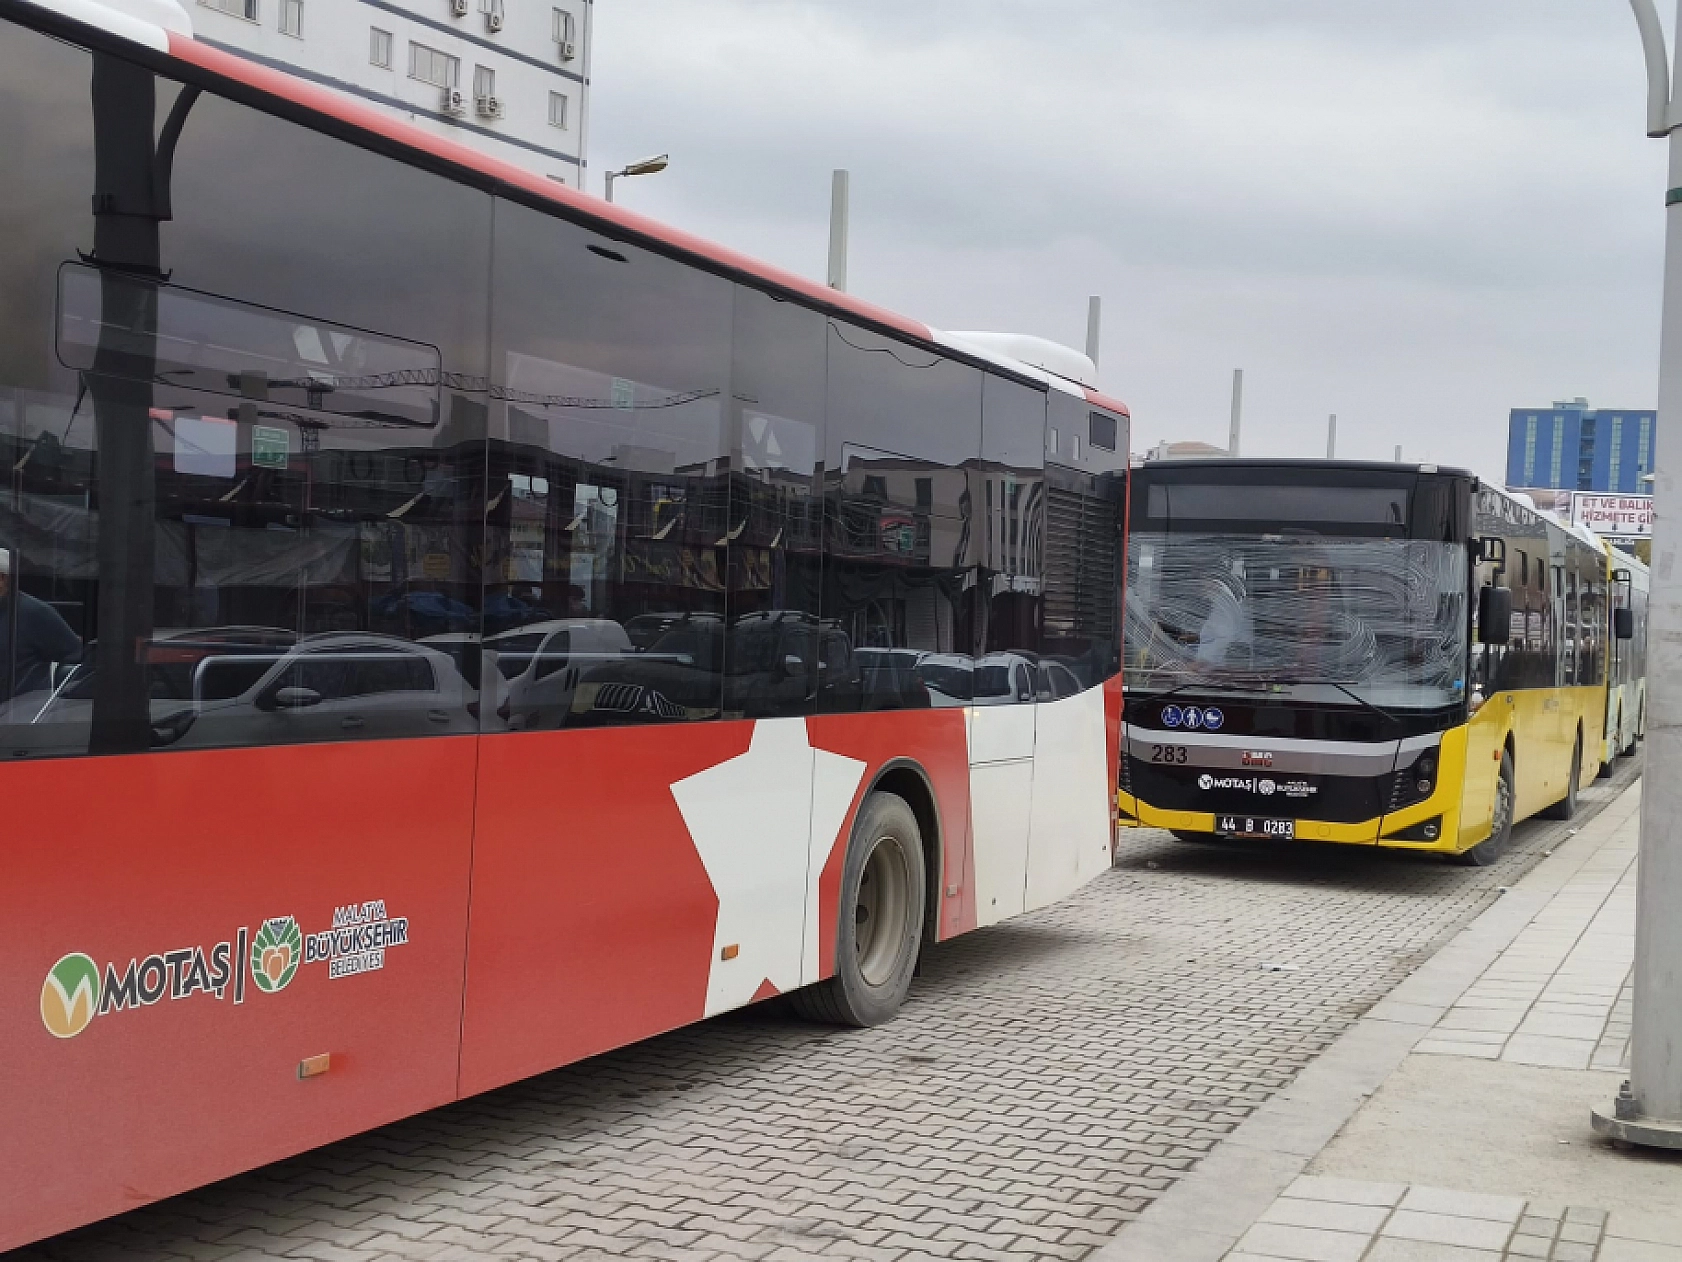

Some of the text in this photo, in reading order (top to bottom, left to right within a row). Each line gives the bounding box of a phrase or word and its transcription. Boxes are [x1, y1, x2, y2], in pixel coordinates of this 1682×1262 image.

[1582, 498, 1598, 508] ET
[1600, 498, 1617, 509] VE
[1581, 508, 1635, 523] HİZMETE
[1151, 744, 1188, 764] 283
[1221, 816, 1293, 834] 44 B 0283
[332, 899, 388, 928] MALATYA
[98, 941, 231, 1016] MOTAŞ
